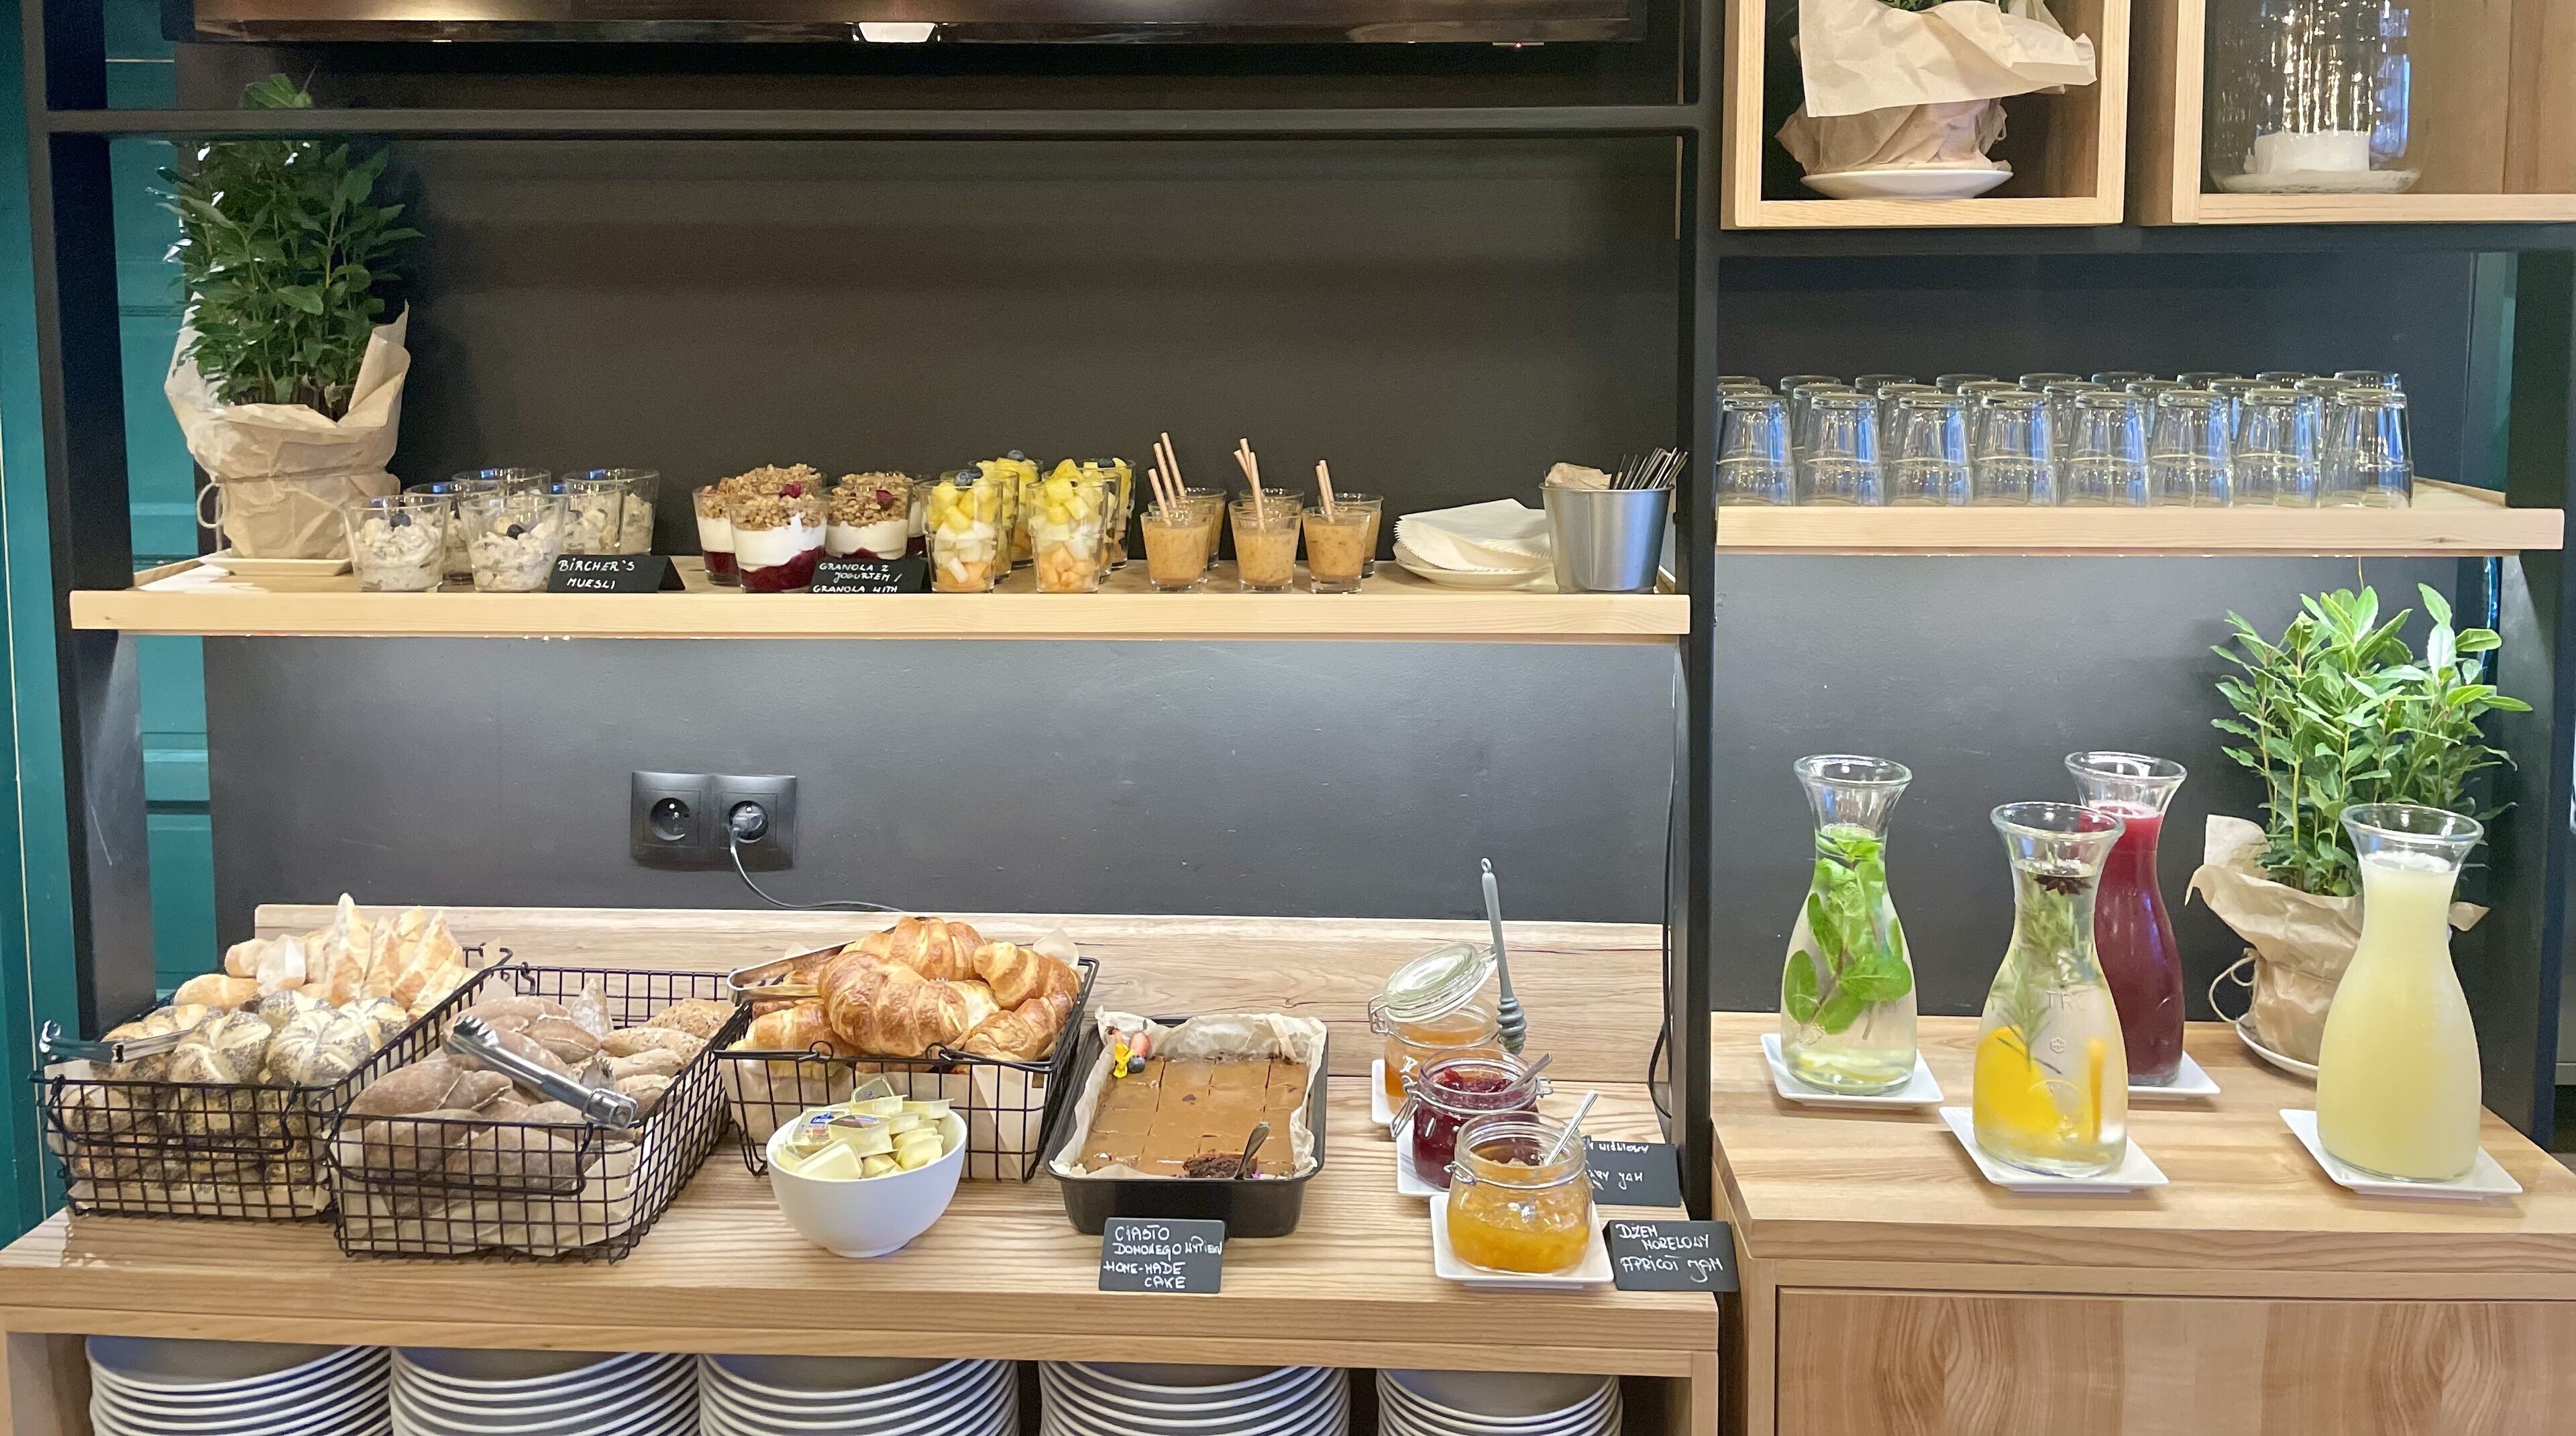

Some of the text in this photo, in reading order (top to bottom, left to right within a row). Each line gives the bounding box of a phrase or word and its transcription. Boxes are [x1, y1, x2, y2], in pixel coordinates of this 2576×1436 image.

[818, 562, 874, 571] GRANOLA
[566, 577, 616, 590] MUESLI
[833, 572, 891, 584] JOGURTEM
[812, 584, 866, 593] GRANOLA
[1617, 1172, 1644, 1190] JAM
[1641, 1234, 1710, 1251] MORELOWY
[1112, 1242, 1182, 1262] DOMOWEGO
[1102, 1260, 1187, 1275] HOME-MADE
[1686, 1257, 1724, 1283] JAM
[1144, 1275, 1187, 1289] CAKE
